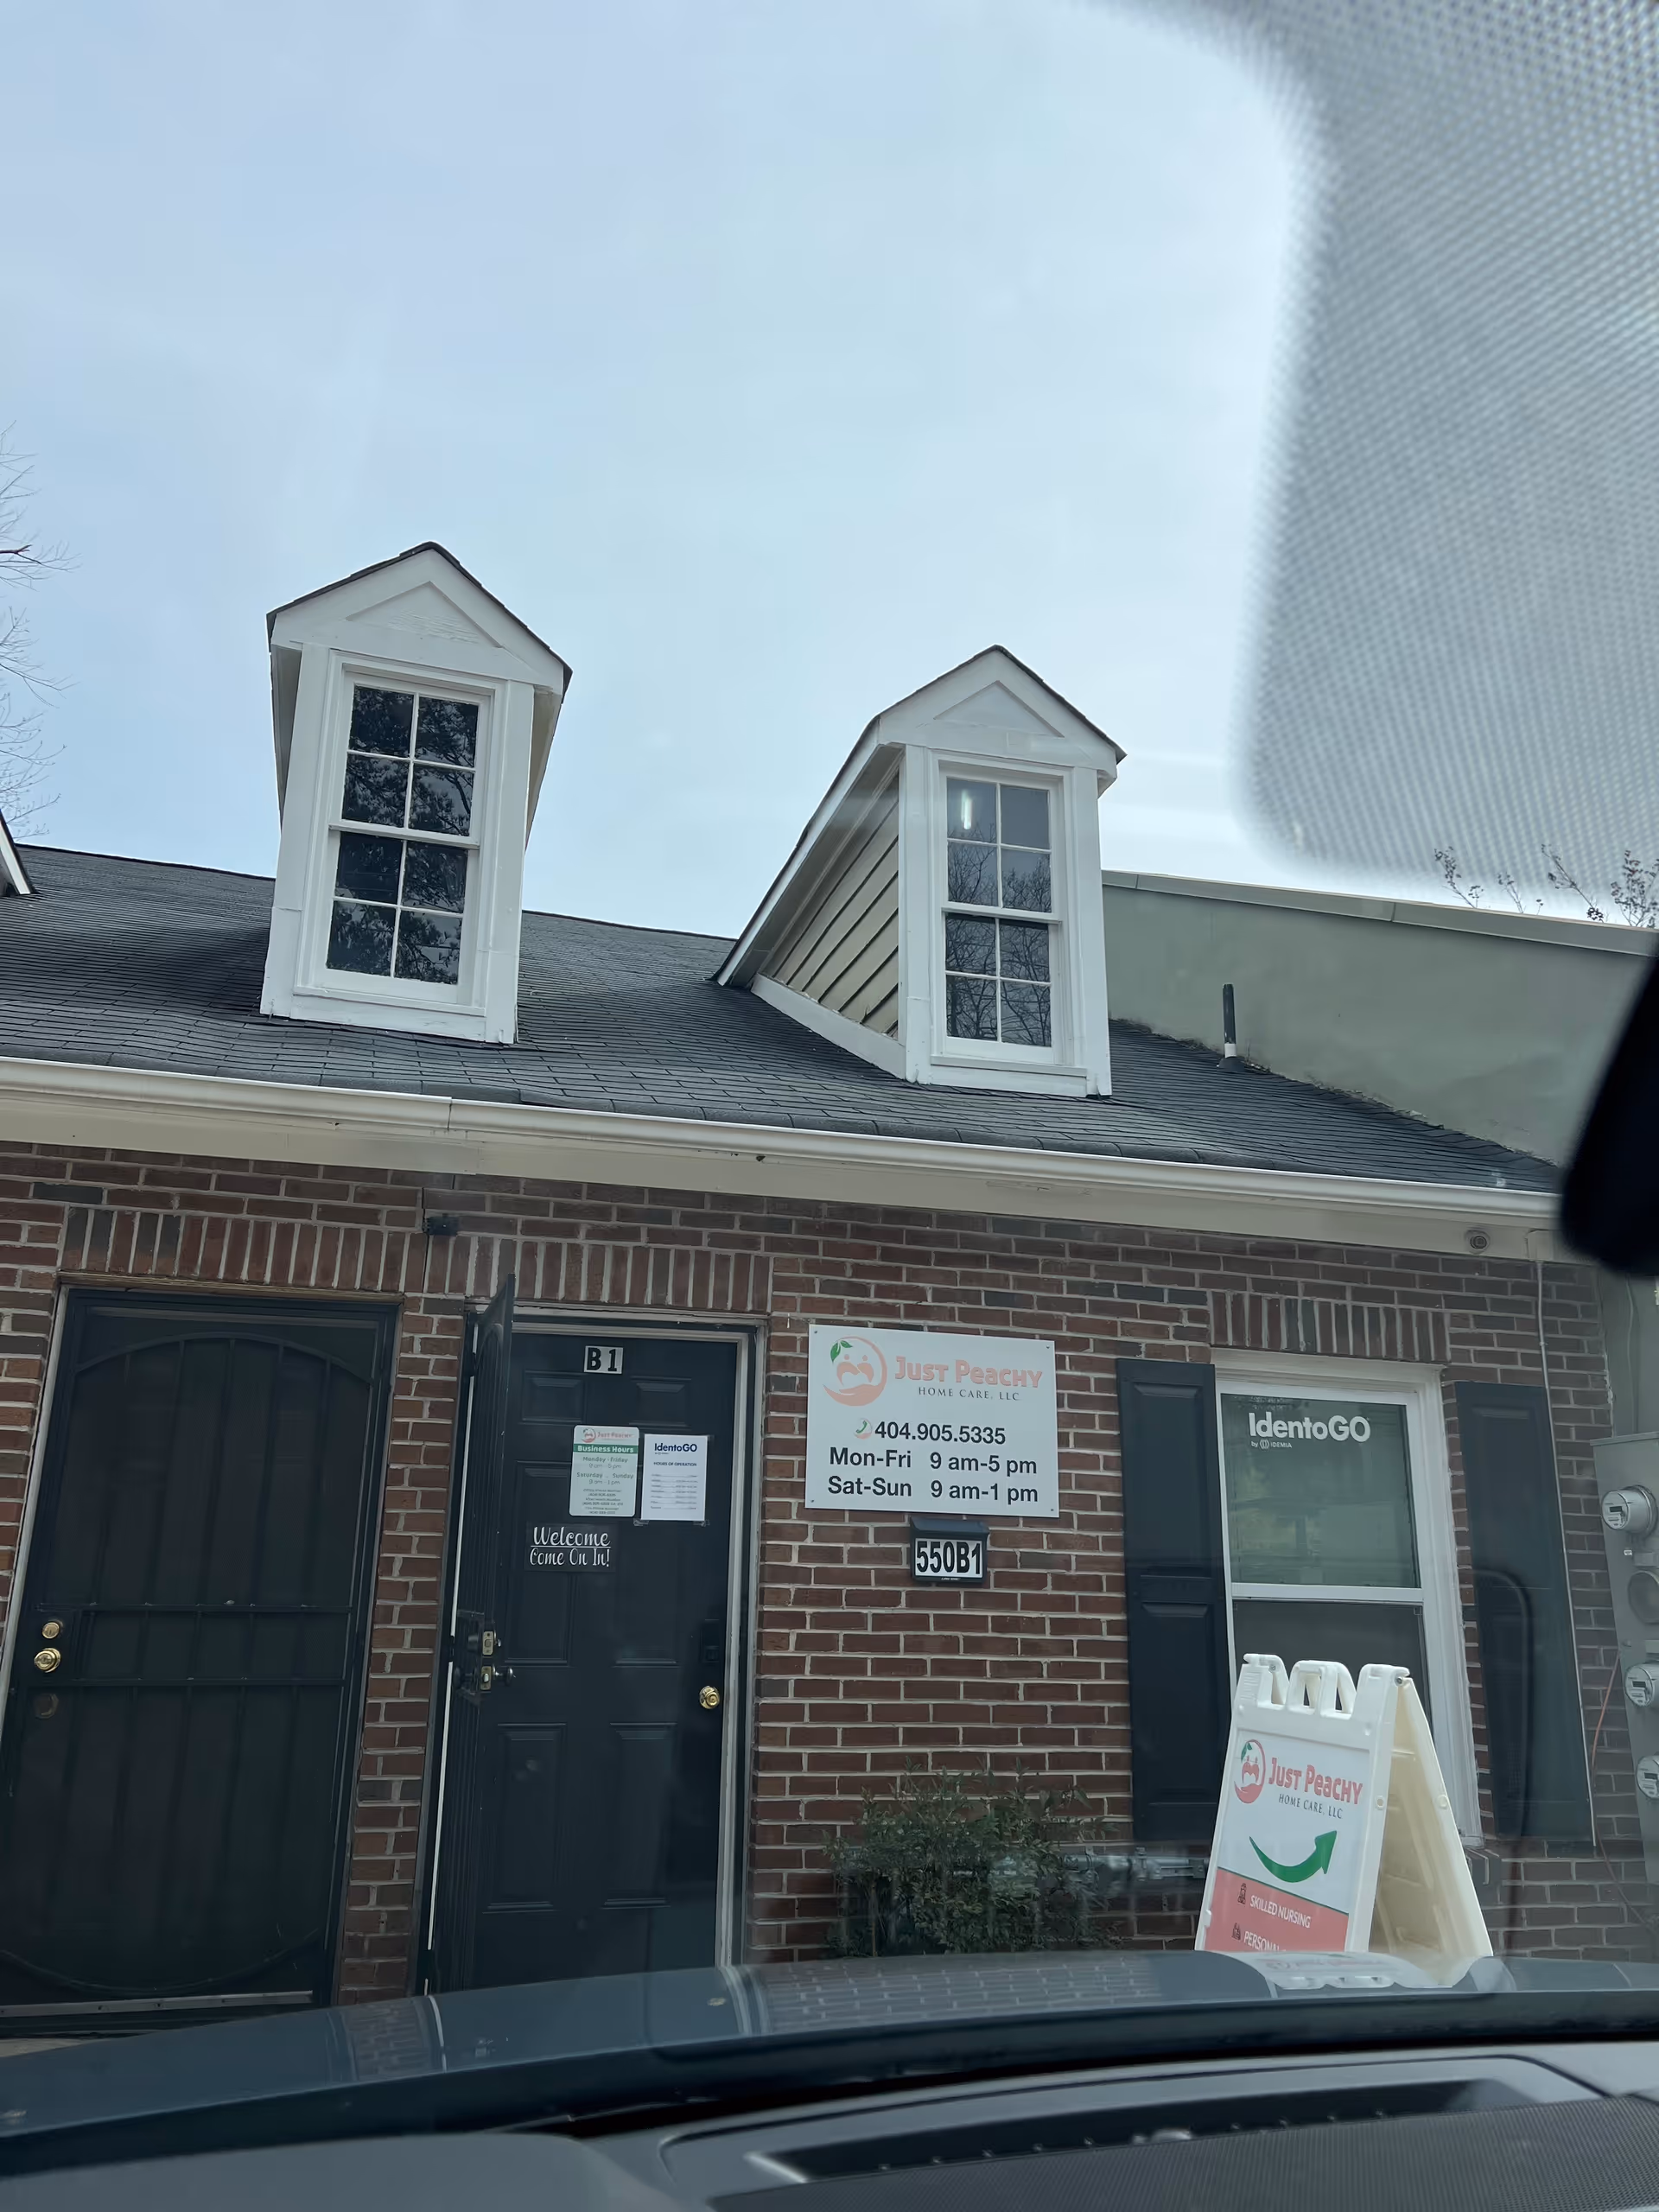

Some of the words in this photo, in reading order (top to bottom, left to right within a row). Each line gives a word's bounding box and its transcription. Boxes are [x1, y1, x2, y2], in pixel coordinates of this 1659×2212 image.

[918, 1386, 954, 1397] HOME
[959, 1389, 993, 1400] CARE,
[999, 1392, 1020, 1402] LLC
[874, 1421, 1007, 1445] 404.905.5335
[1249, 1411, 1370, 1442] IdentoGO
[655, 1443, 697, 1452] IdentoGO
[830, 1446, 912, 1468] Mon-Fri
[930, 1452, 942, 1470] 9
[948, 1455, 1001, 1472] am-5
[1007, 1459, 1038, 1478] pm
[828, 1476, 912, 1497] Sat-Sun
[931, 1480, 943, 1498] 9
[949, 1484, 999, 1501] am-1
[1007, 1487, 1038, 1505] pm
[533, 1526, 611, 1547] Welcome
[530, 1548, 565, 1566] Come
[569, 1548, 588, 1565] On
[593, 1548, 610, 1567] In!
[917, 1541, 980, 1574] 550B1
[1279, 1793, 1300, 1808] HOME
[1303, 1799, 1325, 1815] CARE,
[1328, 1806, 1344, 1819] LLC
[1249, 1895, 1277, 1915] SKILLED
[1277, 1905, 1311, 1929] NURSING
